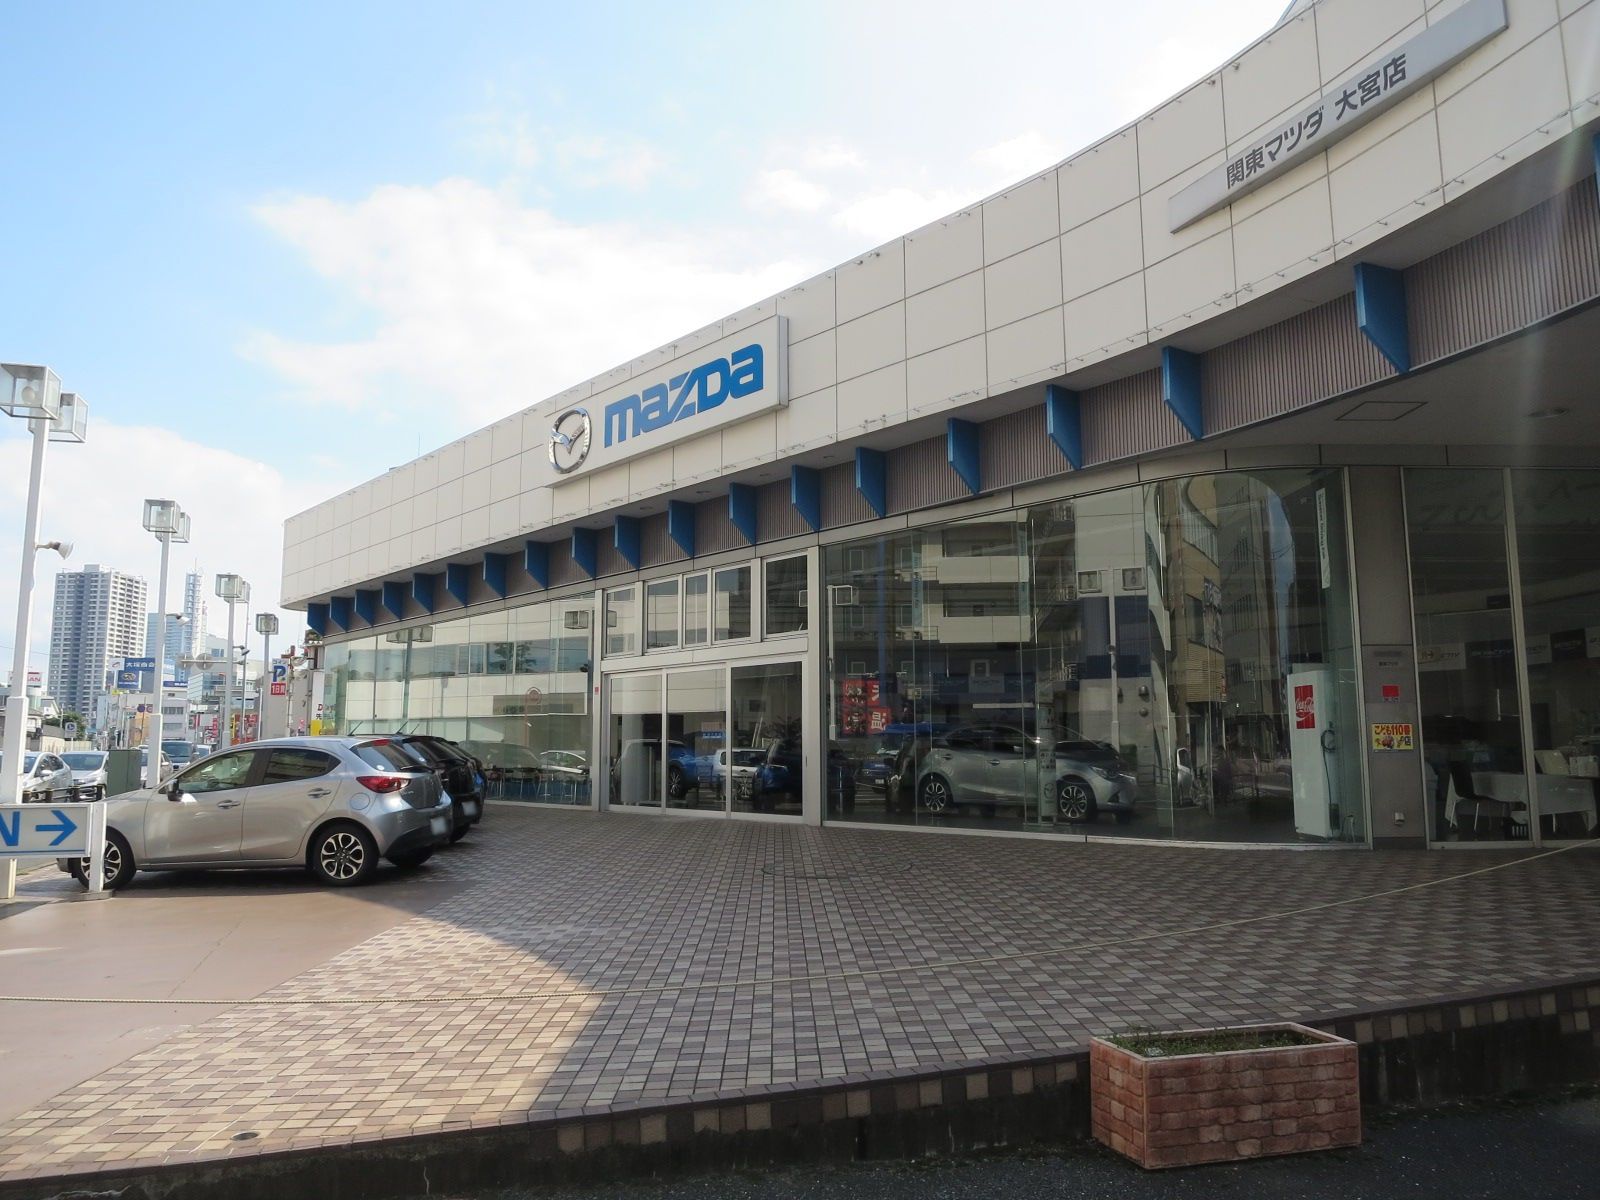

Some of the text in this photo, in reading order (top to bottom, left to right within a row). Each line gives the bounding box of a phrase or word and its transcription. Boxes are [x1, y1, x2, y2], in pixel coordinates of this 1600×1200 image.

[1226, 53, 1407, 189] 関東マツダ 大宮店
[604, 343, 764, 449] mazda
